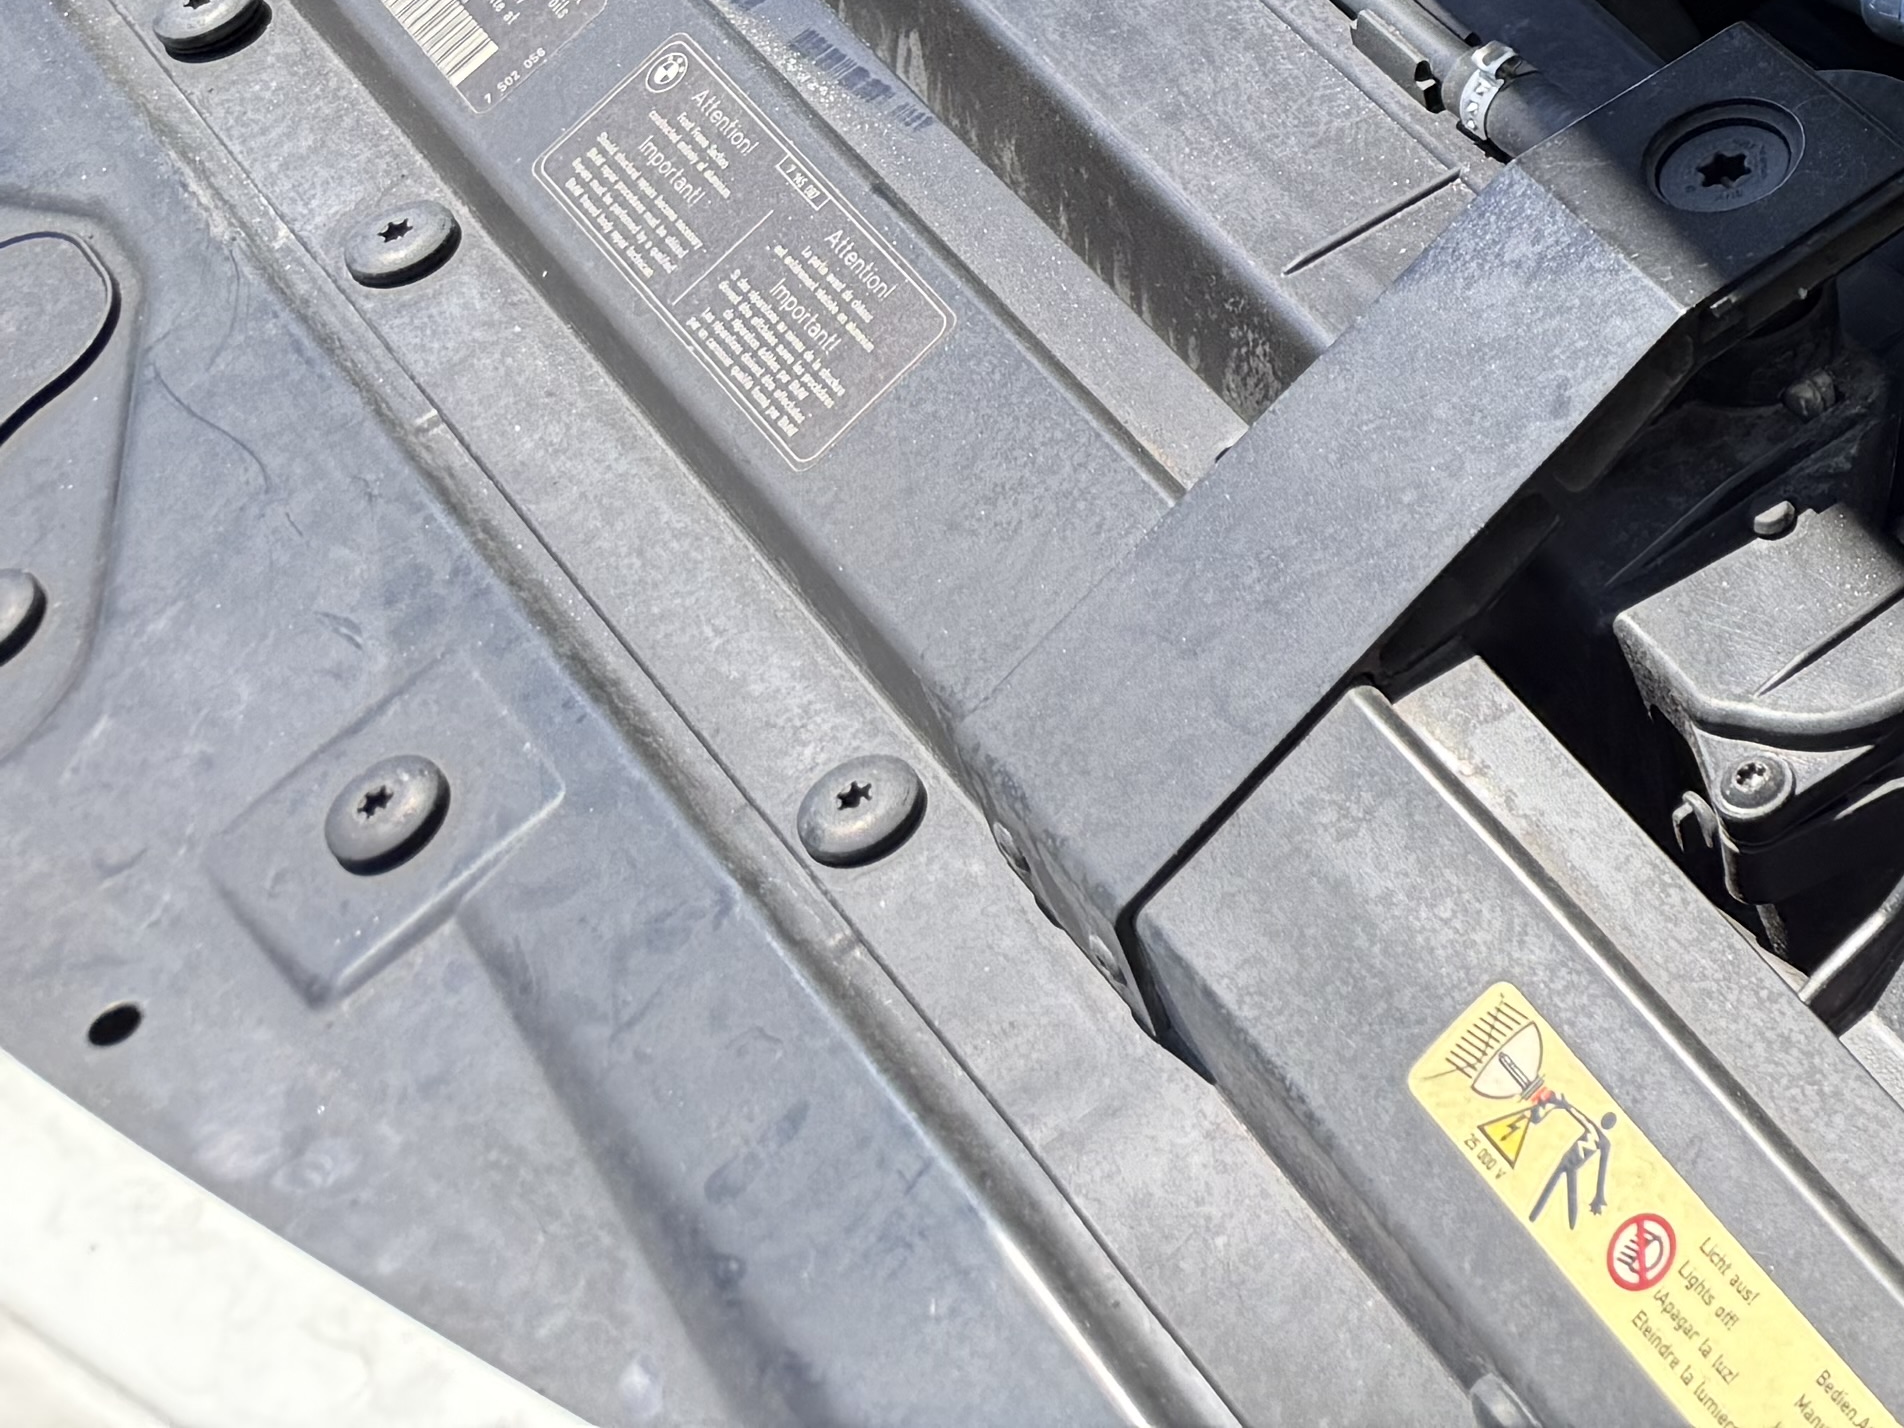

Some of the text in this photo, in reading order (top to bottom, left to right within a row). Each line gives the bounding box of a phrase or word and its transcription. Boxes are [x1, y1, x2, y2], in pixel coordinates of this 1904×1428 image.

[503, 11, 521, 25] at
[691, 90, 759, 156] Attention!
[639, 135, 705, 206] Important!
[825, 230, 896, 301] Attention!
[770, 278, 841, 355] Important!
[1678, 1260, 1739, 1331] Lights off!
[1699, 1237, 1760, 1306] Licht aus!
[1680, 1365, 1694, 1386] la
[1698, 1340, 1712, 1358] la
[1712, 1358, 1739, 1385] luz!
